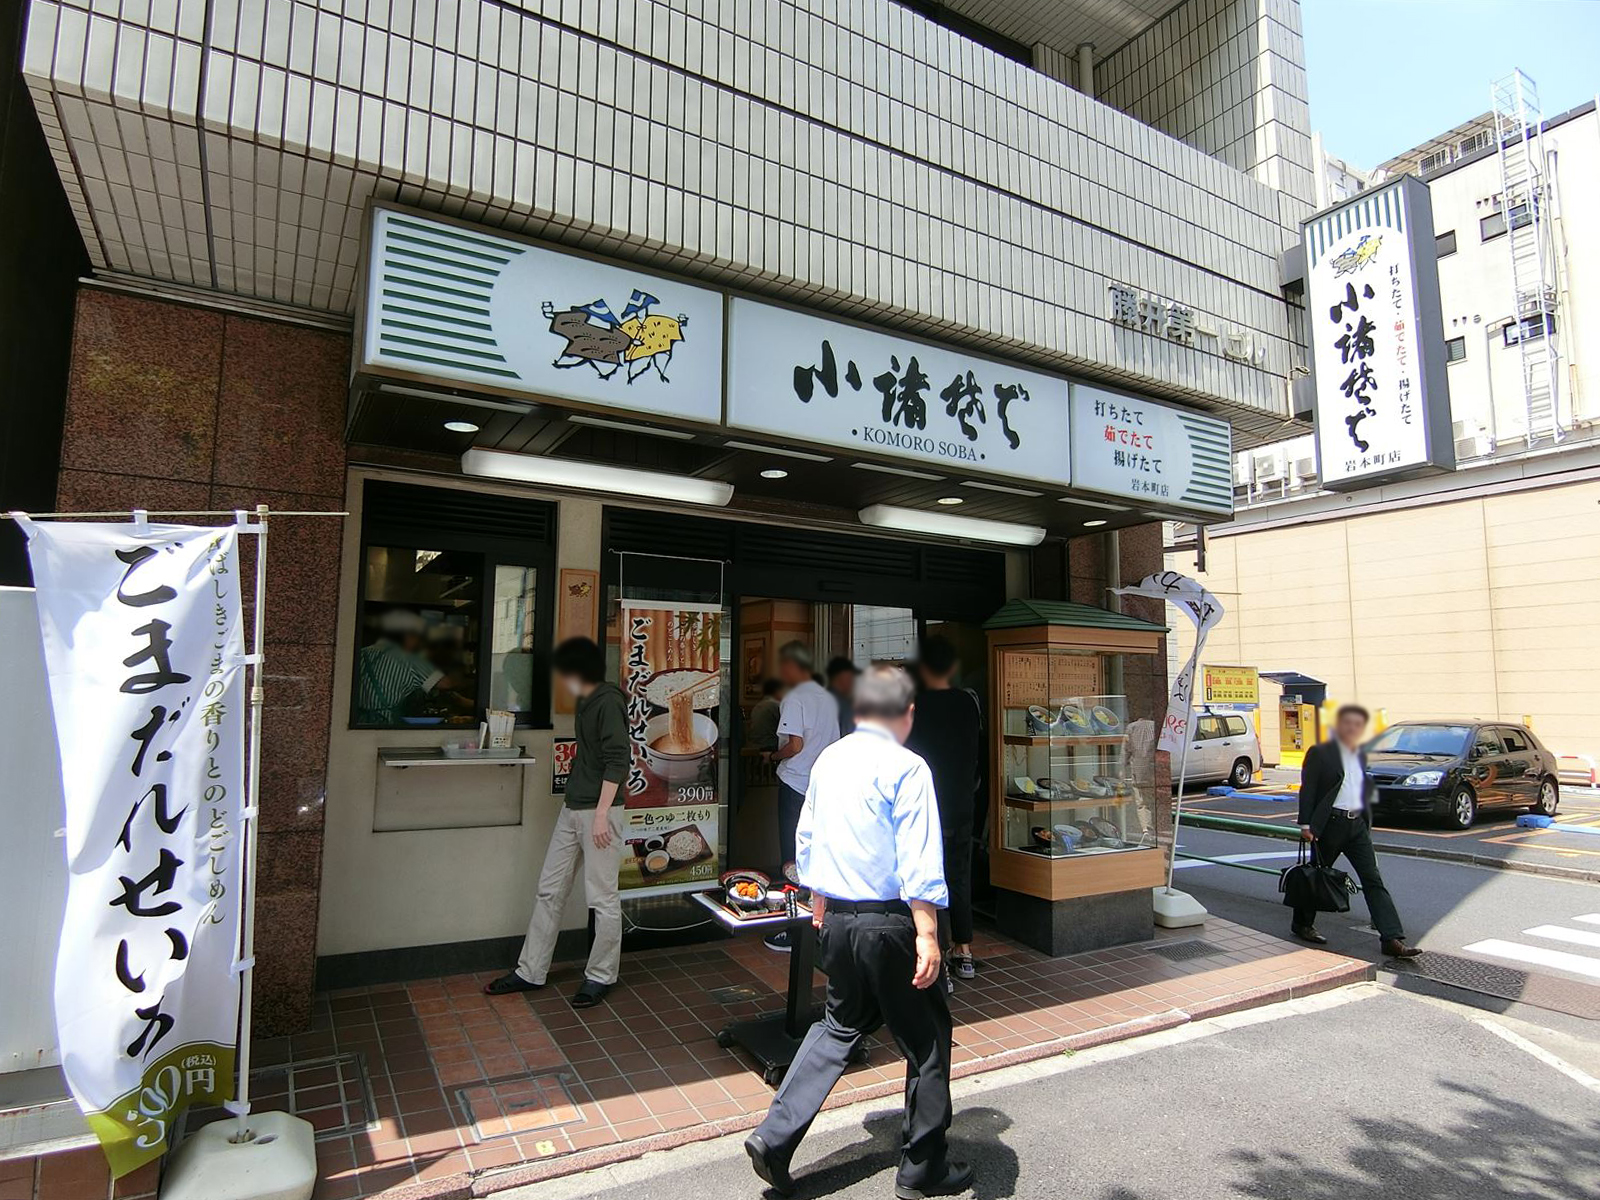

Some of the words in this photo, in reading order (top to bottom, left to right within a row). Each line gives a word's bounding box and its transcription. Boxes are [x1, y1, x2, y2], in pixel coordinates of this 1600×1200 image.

[1094, 399, 1144, 426] 打ちたて
[863, 426, 935, 453] KOMORO
[938, 441, 977, 461] SOBA
[1104, 424, 1153, 450] 茹でたて
[1113, 449, 1163, 474] 揚げたて
[1344, 450, 1401, 472] 岩本町店
[1131, 478, 1169, 497] 岩本町店
[627, 617, 652, 796] ごまだれせいろ
[677, 786, 714, 803] 390円
[690, 865, 714, 877] 450円
